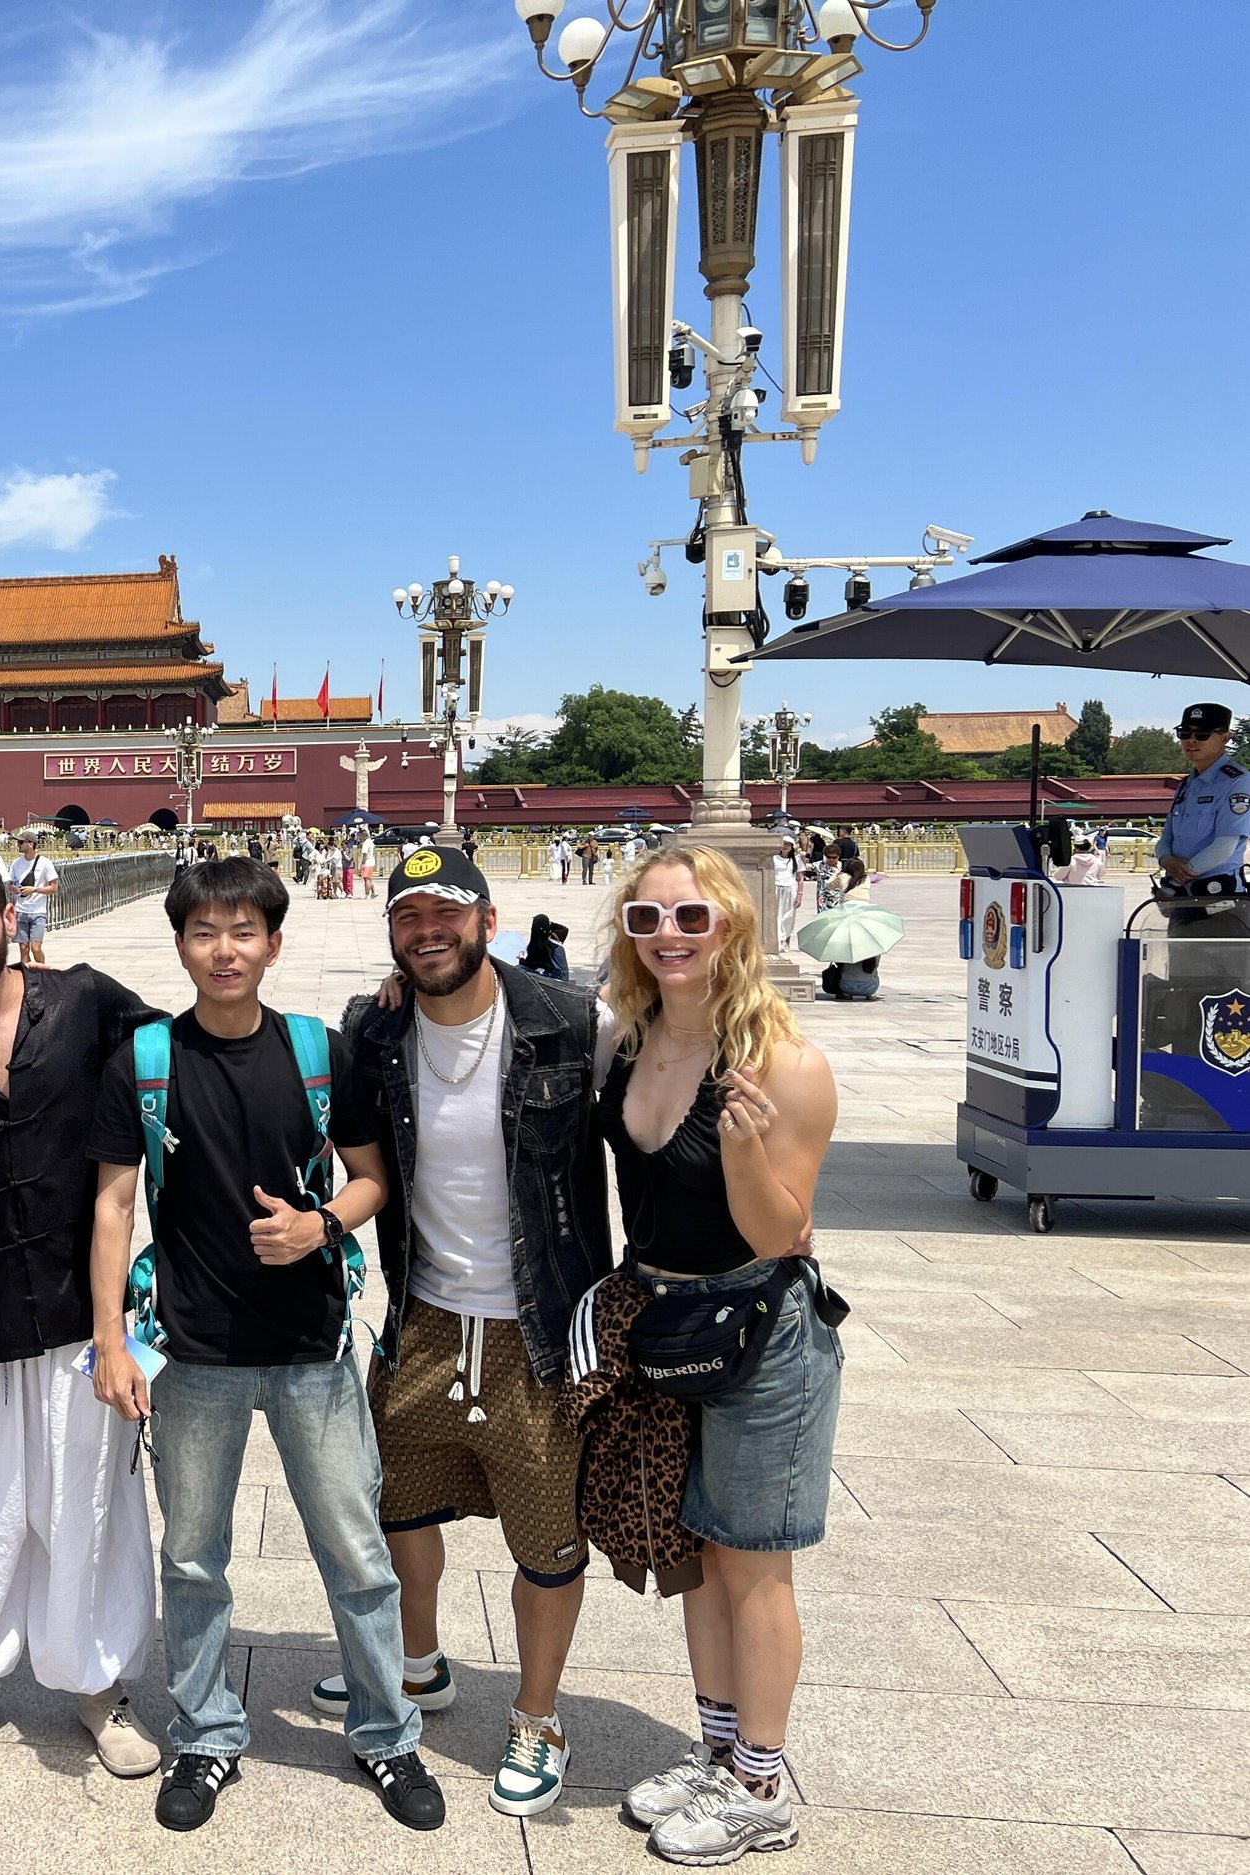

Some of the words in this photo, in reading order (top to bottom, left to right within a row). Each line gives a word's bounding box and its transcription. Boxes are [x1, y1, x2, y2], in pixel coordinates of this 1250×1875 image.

[978, 977, 1013, 1017] 警察
[971, 1026, 1020, 1061] 天安门地区分局
